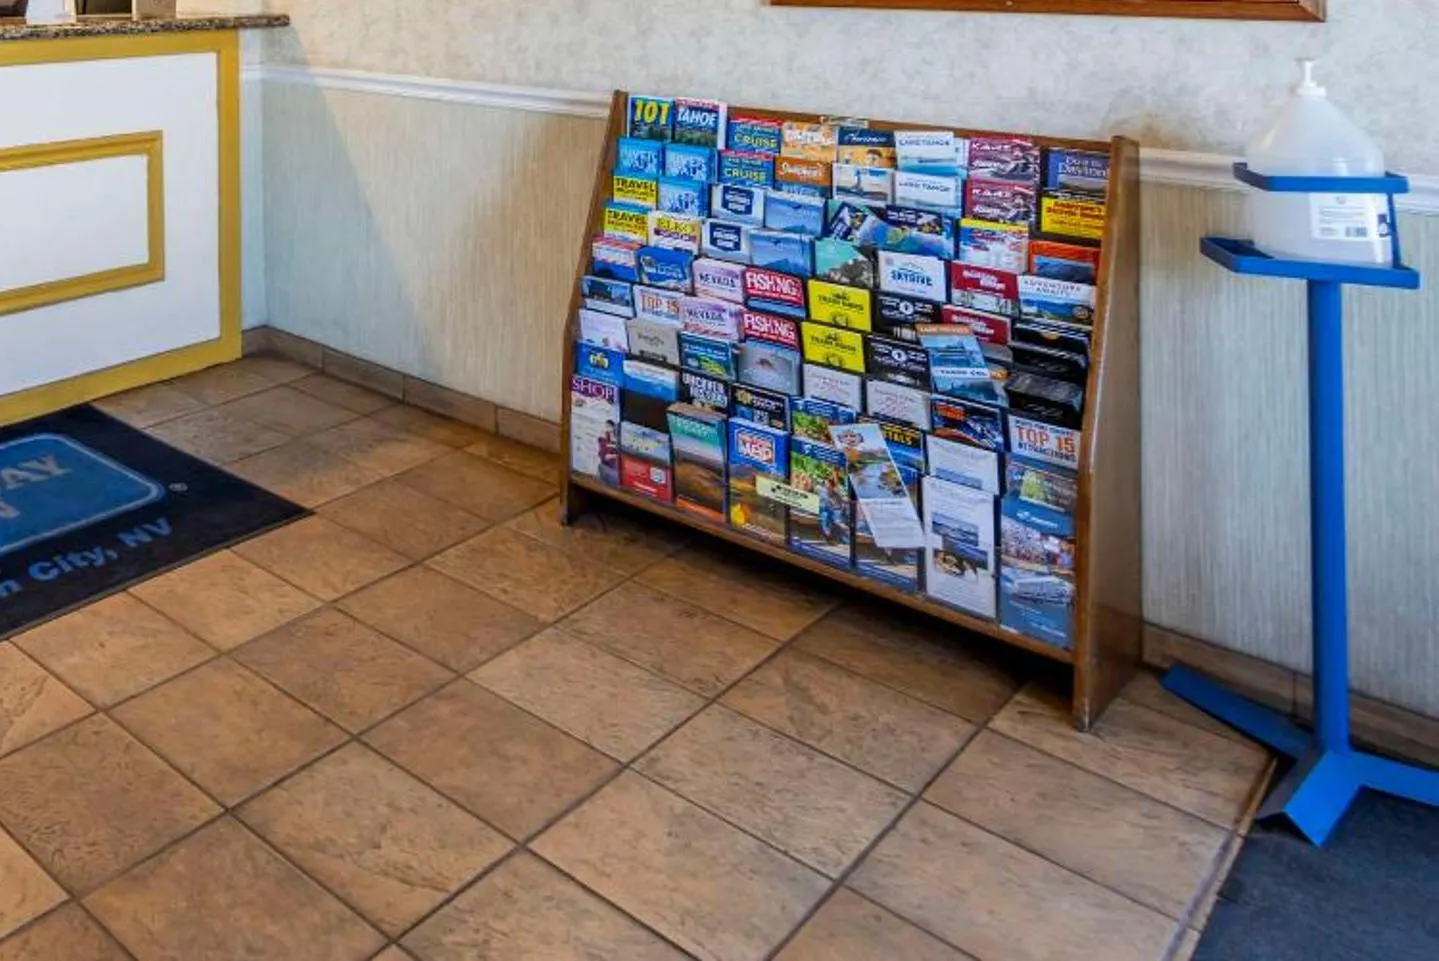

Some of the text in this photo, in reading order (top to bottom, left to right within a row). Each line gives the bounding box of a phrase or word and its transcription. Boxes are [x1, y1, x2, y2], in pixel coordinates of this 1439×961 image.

[572, 375, 615, 401] SHOP
[1016, 426, 1049, 446] TOP
[1055, 436, 1075, 453] 15
[28, 543, 118, 584] City,
[121, 516, 174, 549] NV
